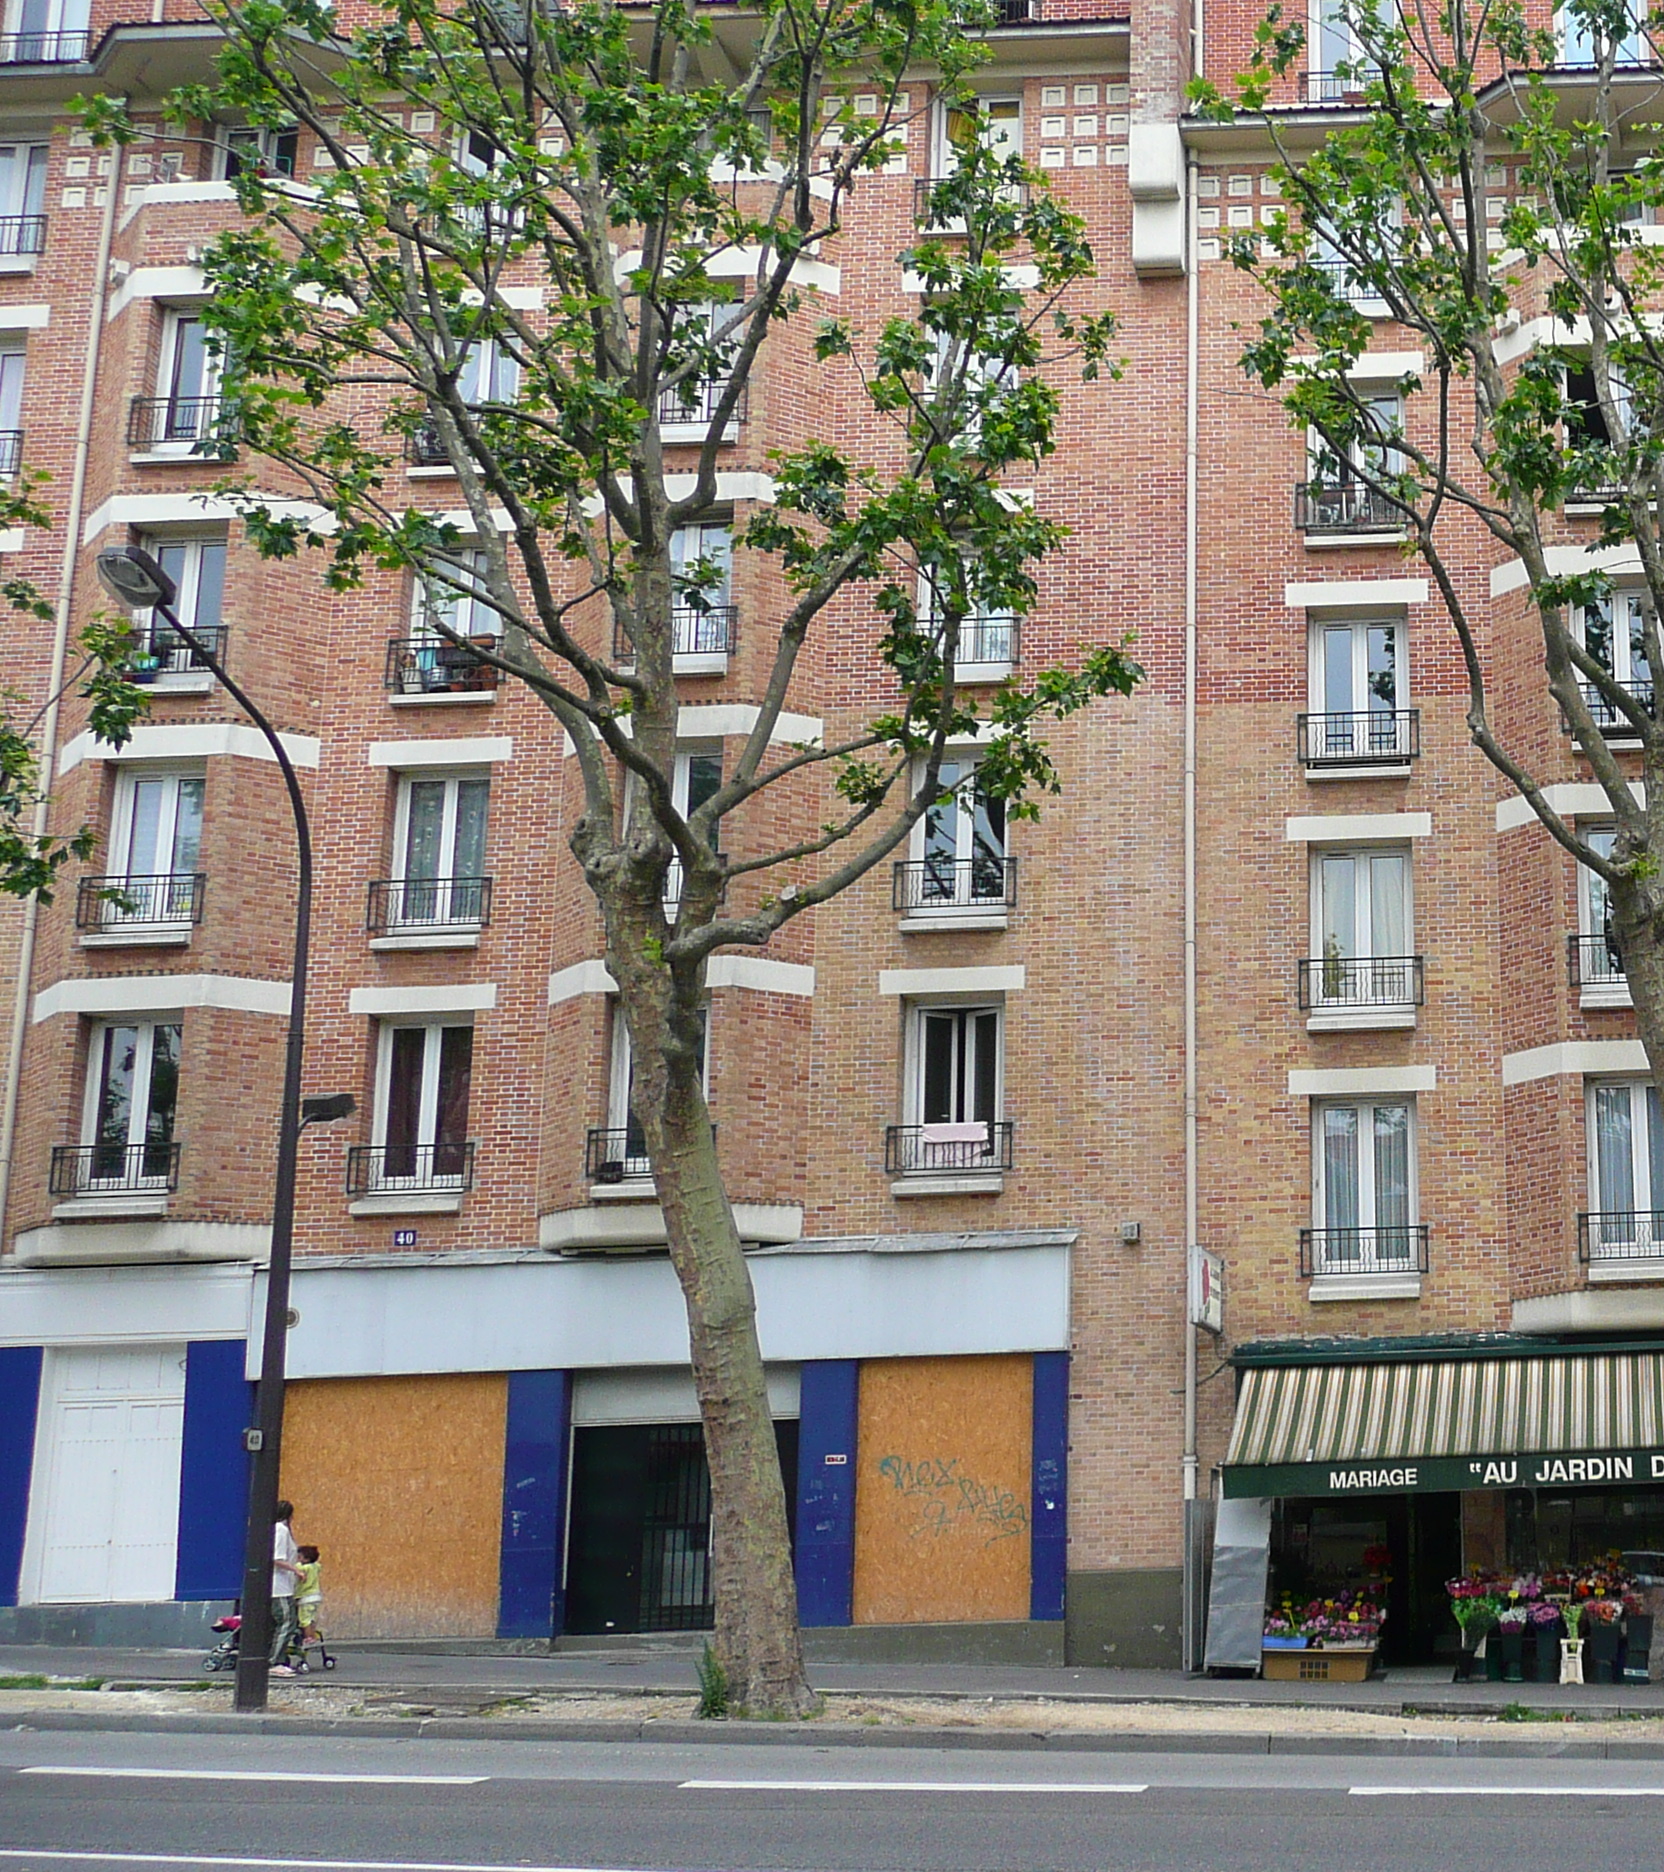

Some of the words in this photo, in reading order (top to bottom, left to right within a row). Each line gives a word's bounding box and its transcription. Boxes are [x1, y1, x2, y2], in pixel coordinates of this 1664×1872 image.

[396, 1232, 413, 1245] 40
[1329, 1467, 1418, 1489] MARIAGE
[1535, 1456, 1633, 1482] JARDIN
